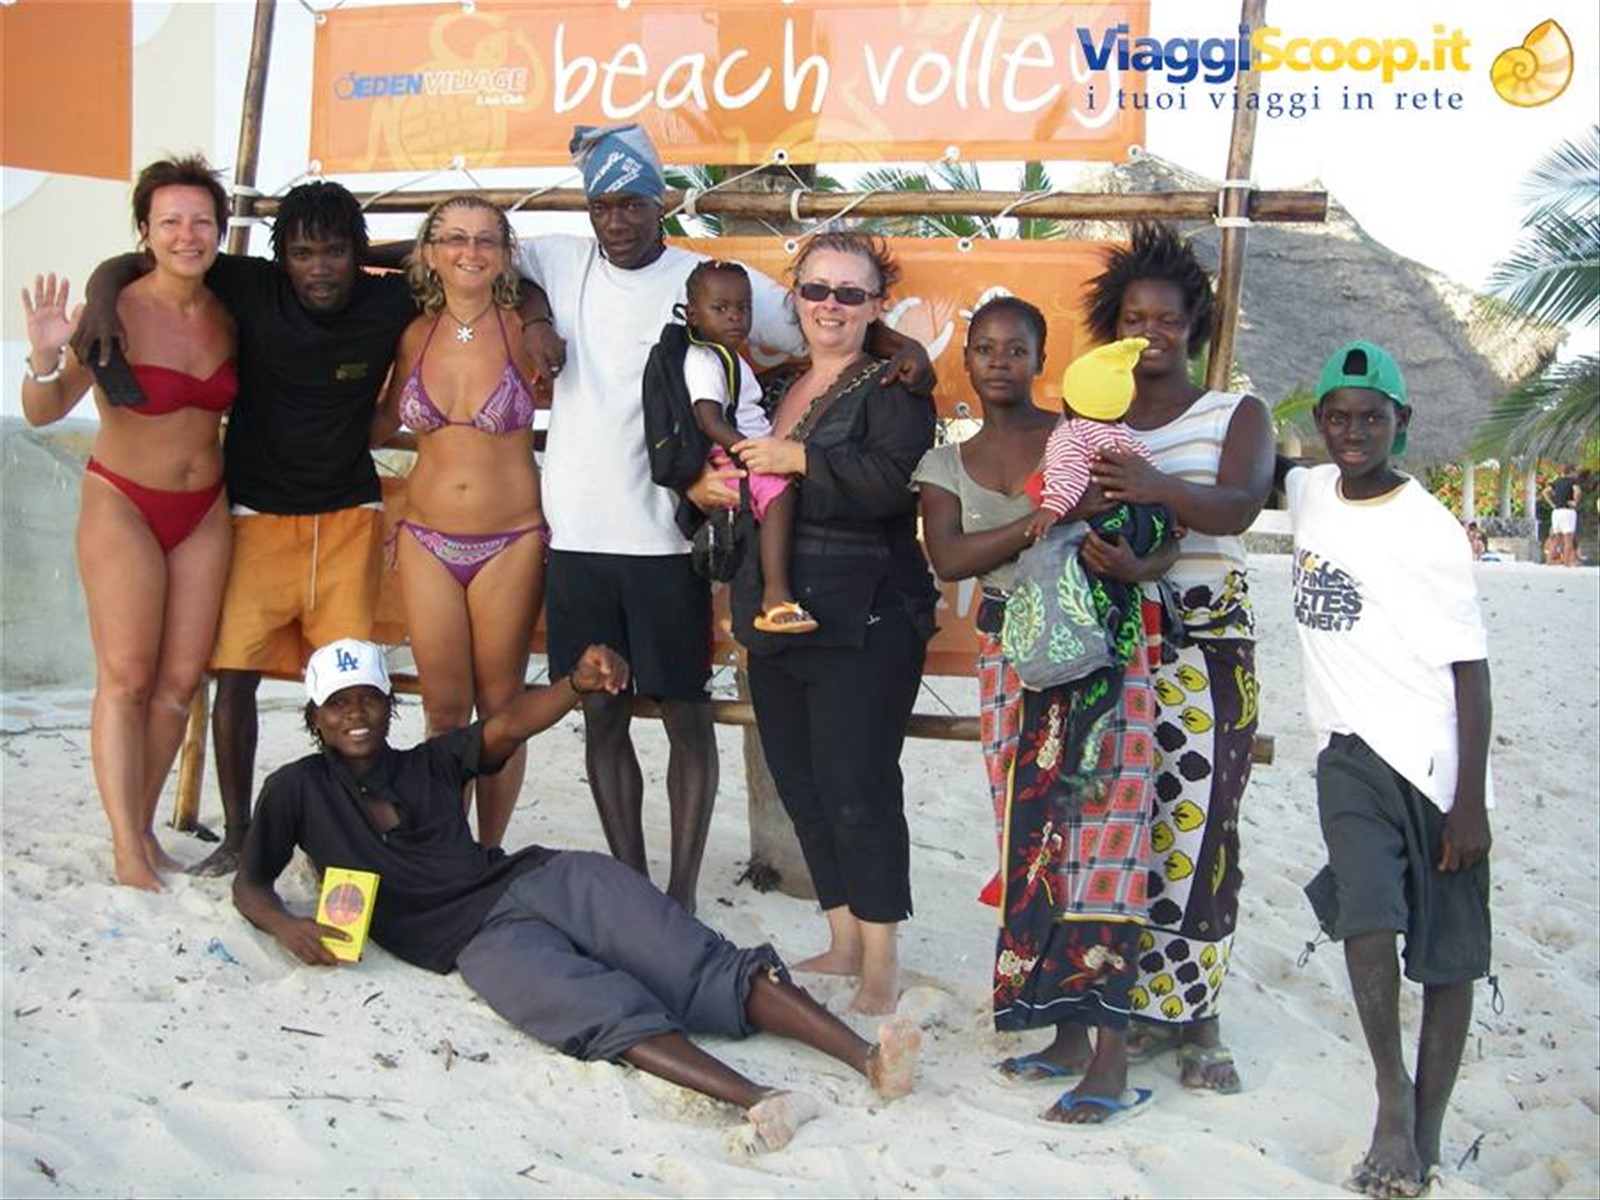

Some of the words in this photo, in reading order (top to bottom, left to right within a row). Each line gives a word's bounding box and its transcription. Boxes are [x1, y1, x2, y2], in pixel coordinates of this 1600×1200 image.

[553, 19, 828, 119] beach
[864, 14, 1121, 128] volley
[336, 648, 358, 672] LA
